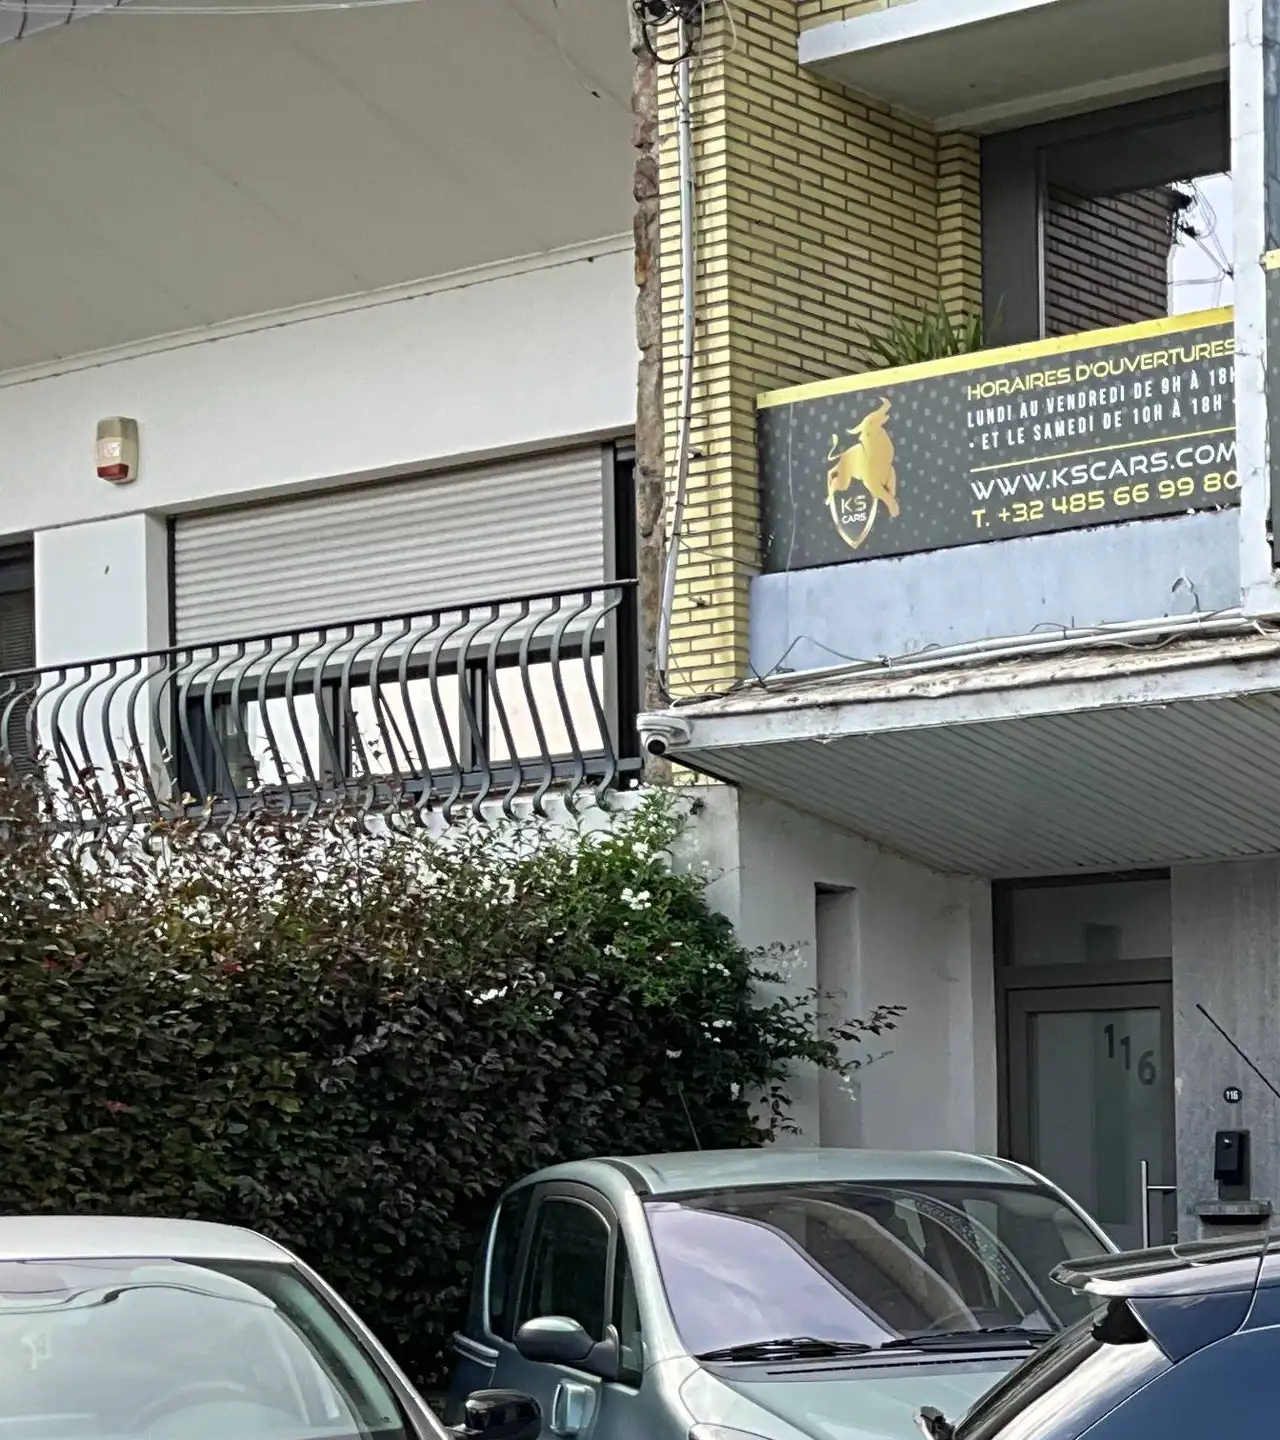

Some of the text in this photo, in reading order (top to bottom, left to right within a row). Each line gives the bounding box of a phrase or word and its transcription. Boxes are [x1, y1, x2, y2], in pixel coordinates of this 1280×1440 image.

[967, 338, 1235, 400] HORAIRES D'OUVERTURES
[967, 405, 1012, 428] LUNDI
[1020, 400, 1039, 419] AU
[1046, 385, 1125, 415] VENDREDI
[1133, 380, 1152, 400] DE
[1161, 375, 1181, 395] 9H
[982, 431, 999, 450] ET
[1008, 427, 1025, 446] LE
[1033, 414, 1094, 442] SAMEDI
[1103, 410, 1122, 430] DE
[1132, 403, 1163, 425] 10H
[1191, 393, 1222, 416] 18H
[970, 442, 1238, 501] WWW.KSCARS.COM
[841, 495, 867, 514] KS
[842, 512, 867, 524] CARS
[971, 508, 991, 529] T.
[998, 500, 1045, 524] +32
[1051, 491, 1105, 515] 485
[1112, 482, 1150, 505] 66
[1157, 476, 1195, 499] 99
